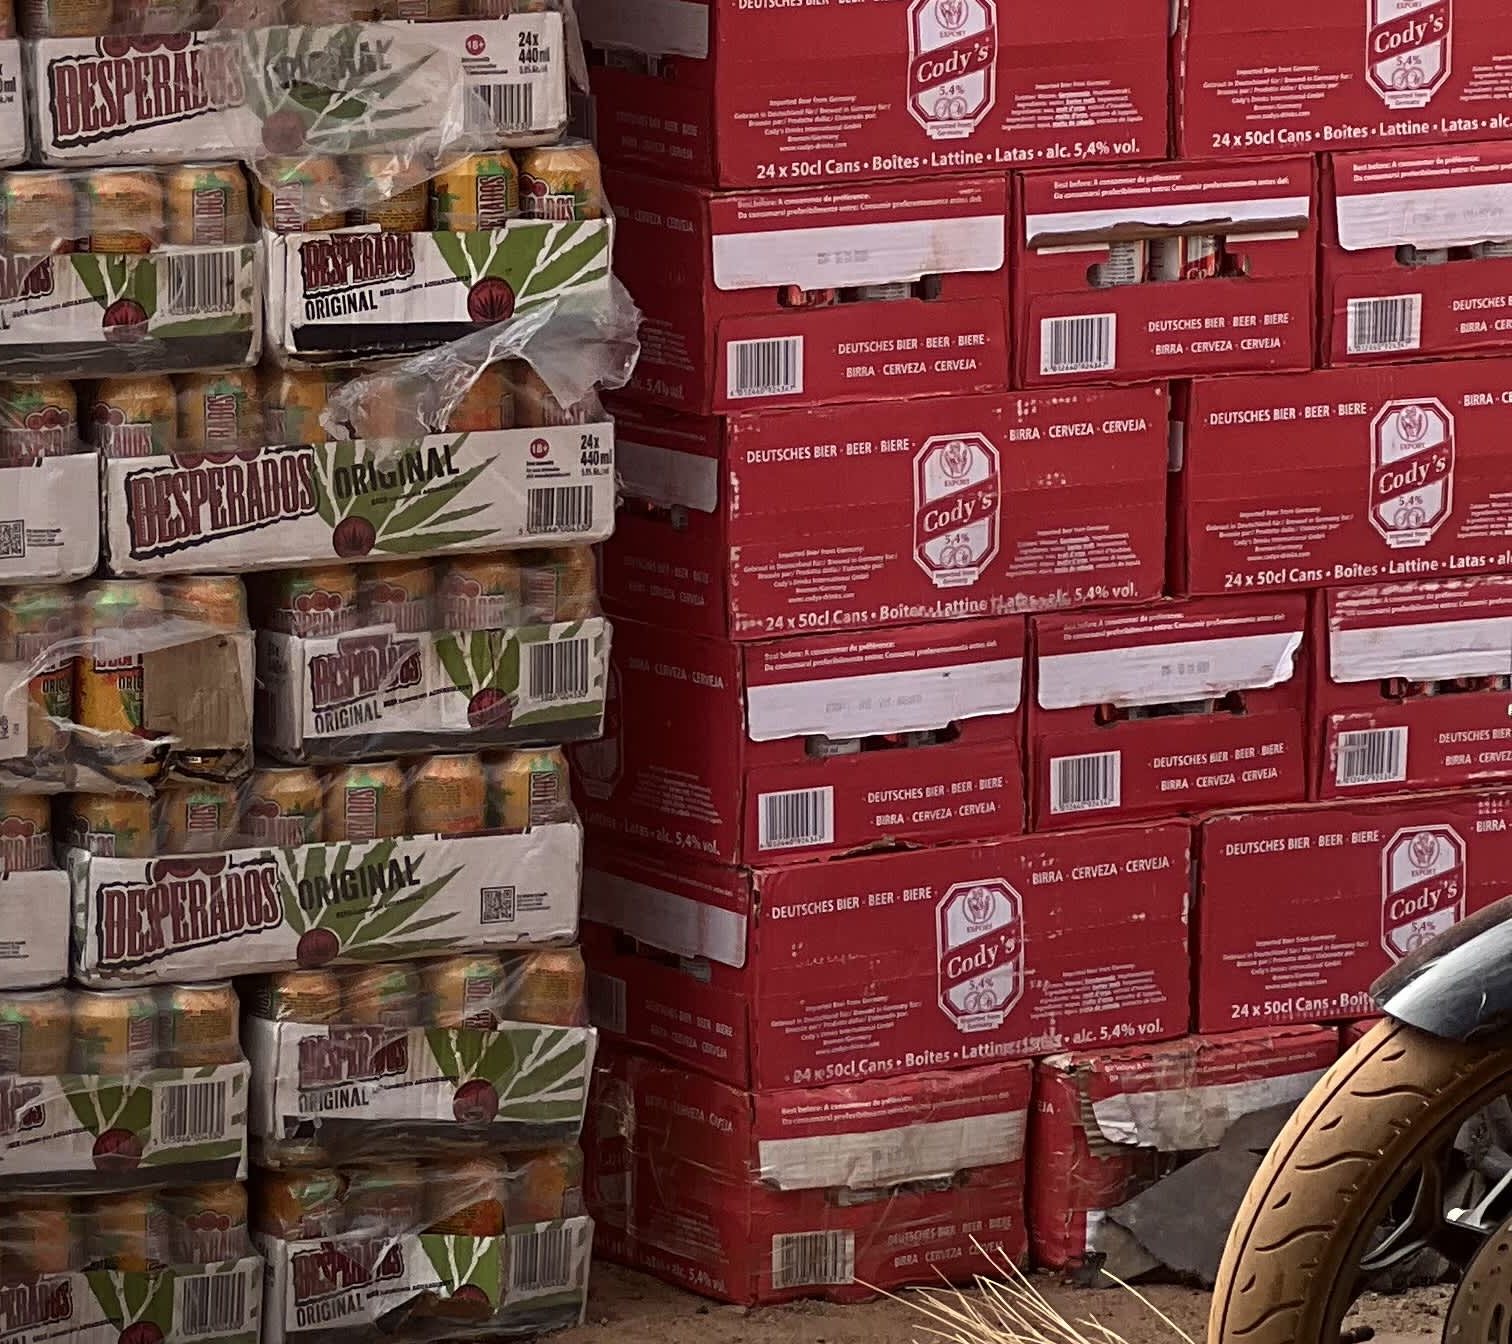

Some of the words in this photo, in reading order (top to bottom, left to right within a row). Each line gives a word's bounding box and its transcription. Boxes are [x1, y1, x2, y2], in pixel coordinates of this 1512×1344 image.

[1374, 13, 1444, 53] Cody's
[916, 43, 988, 84] Cody's
[55, 43, 247, 135] DESPERADOS
[756, 164, 775, 179] 24
[791, 159, 821, 176] 50cl
[825, 159, 860, 174] Cans
[872, 154, 919, 170] Boîtes
[931, 150, 983, 166] Lattine
[995, 148, 1034, 162] Latas
[1046, 143, 1071, 158] alc.
[1073, 141, 1110, 158] 5,4%
[1113, 138, 1140, 153] vol.
[305, 291, 377, 320] ORIGINAL
[838, 340, 894, 354] DEUTSCHES
[896, 338, 918, 350] BIER
[926, 336, 950, 348] BEER
[958, 333, 984, 346] BIERE
[846, 366, 875, 378] BIRRA
[882, 362, 926, 375] CERVEZA
[934, 359, 976, 371] CERVEJA
[1378, 454, 1446, 494] Cody's
[130, 453, 315, 548] DESPERADOS
[335, 444, 460, 500] ORIGINAL
[923, 492, 992, 532] Cody's
[1224, 573, 1242, 587] 24
[1256, 568, 1286, 585] 50cl
[1289, 568, 1322, 582] Cans
[1334, 563, 1378, 578] Boîtes
[1388, 558, 1438, 574] Lattine
[1449, 555, 1485, 568] Latas
[315, 701, 382, 734] ORIGINAL
[867, 788, 923, 803] DEUTSCHES
[925, 785, 944, 797] BIER
[951, 781, 972, 794] BEER
[979, 776, 1002, 790] BIERE
[876, 813, 904, 826] BIRRA
[912, 808, 952, 822] CERVEZA
[958, 801, 996, 816] CERVEJA
[299, 857, 421, 910] ORIGINAL
[1390, 880, 1457, 919] Cody's
[947, 936, 1016, 978] Cody's
[295, 1295, 365, 1327] ORIGINAL
